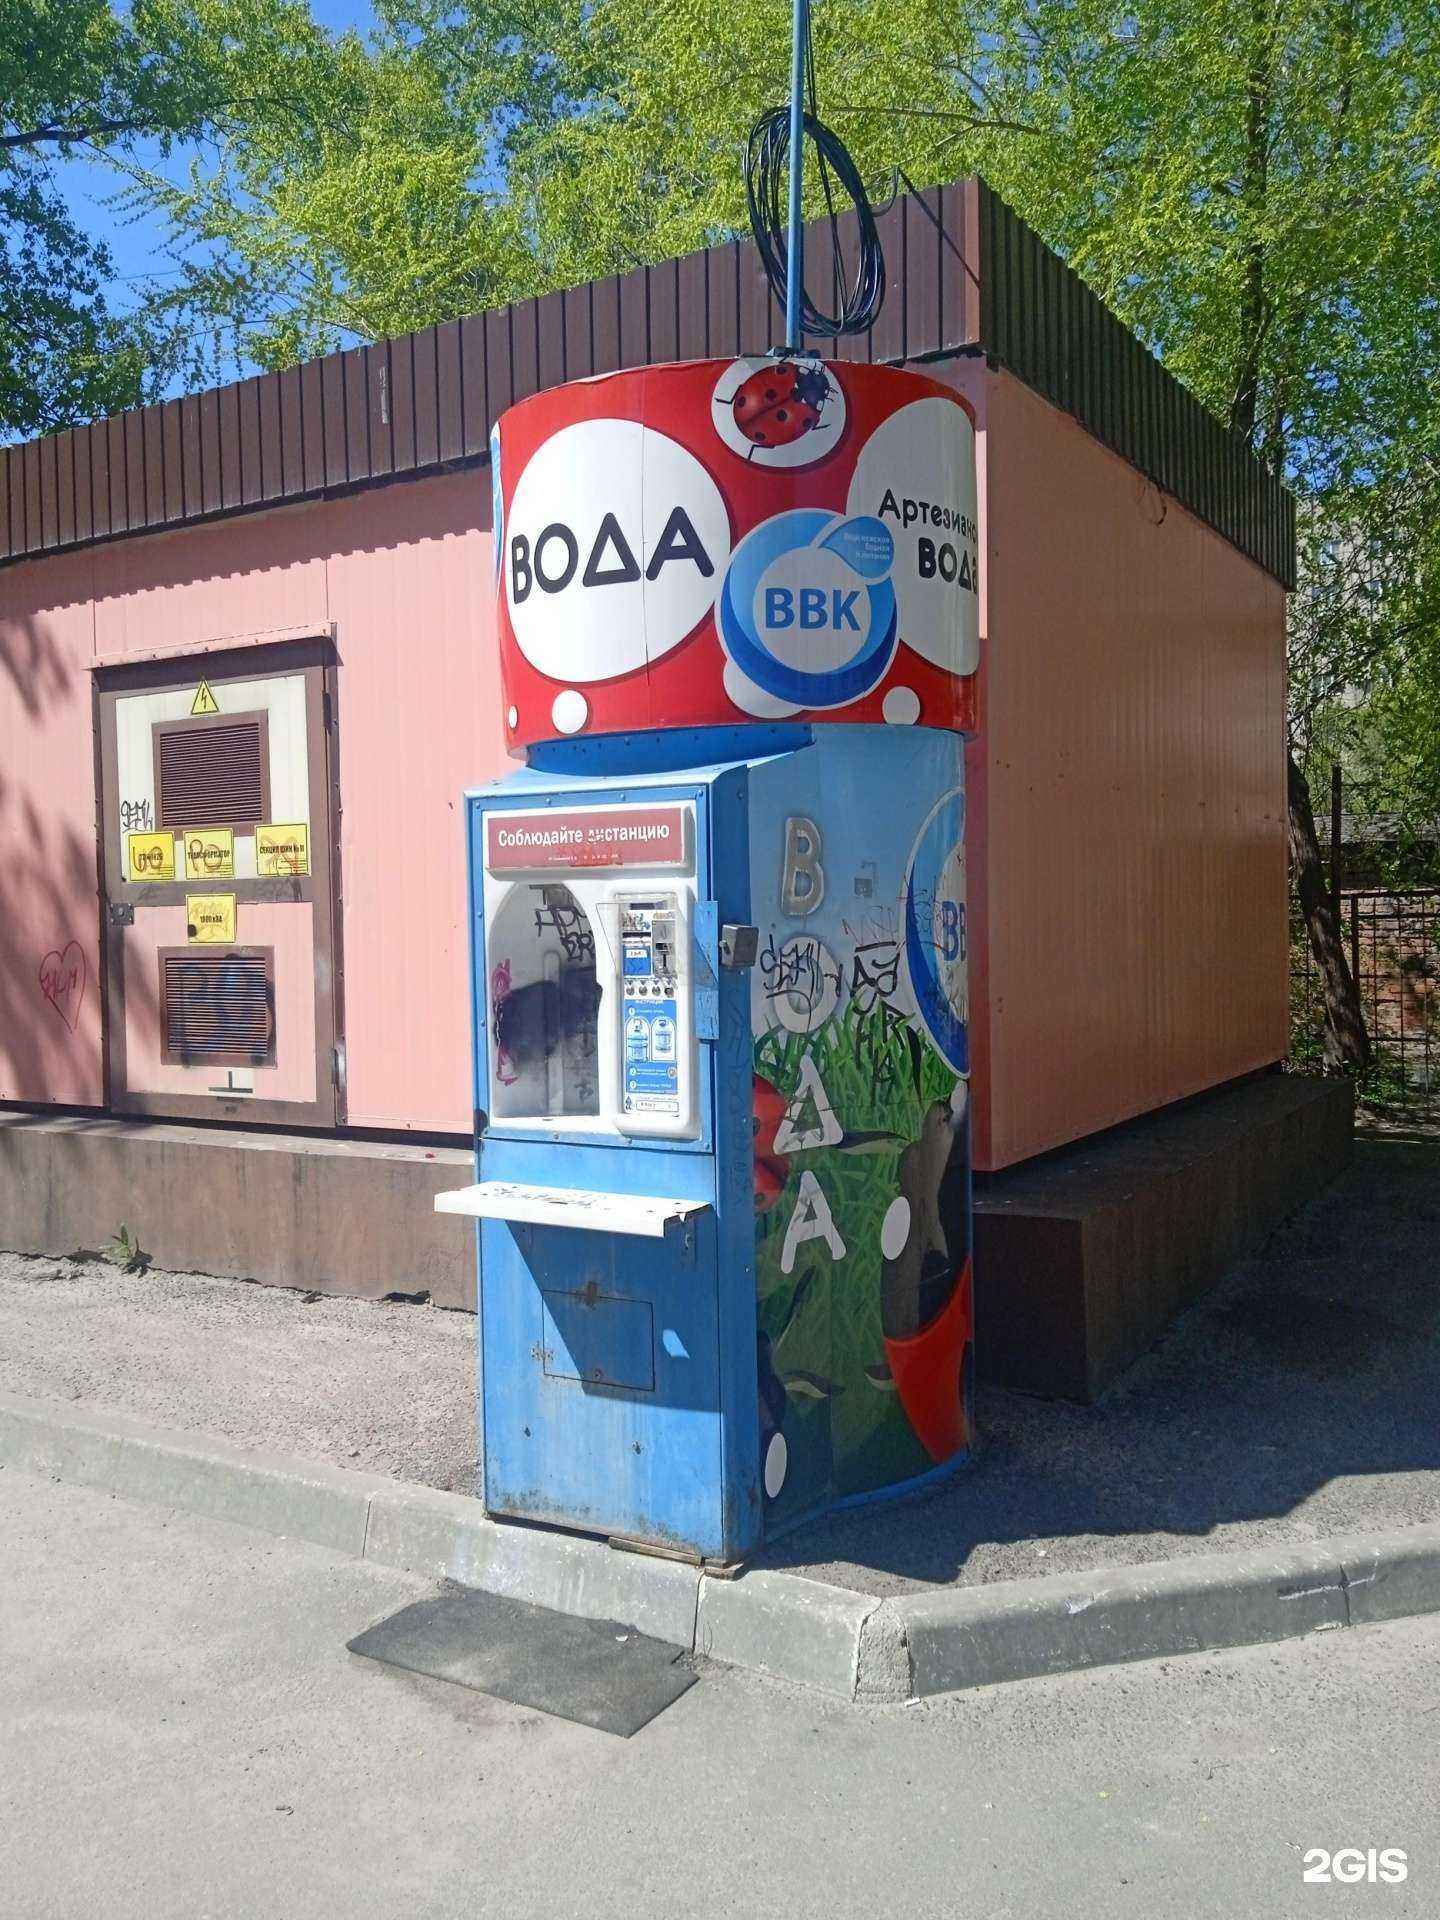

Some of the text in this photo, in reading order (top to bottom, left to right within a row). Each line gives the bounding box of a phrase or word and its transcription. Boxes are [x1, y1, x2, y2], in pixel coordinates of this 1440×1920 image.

[510, 505, 715, 605] ВОДА
[764, 586, 862, 632] ВВК
[498, 827, 583, 847] Соблюдайте
